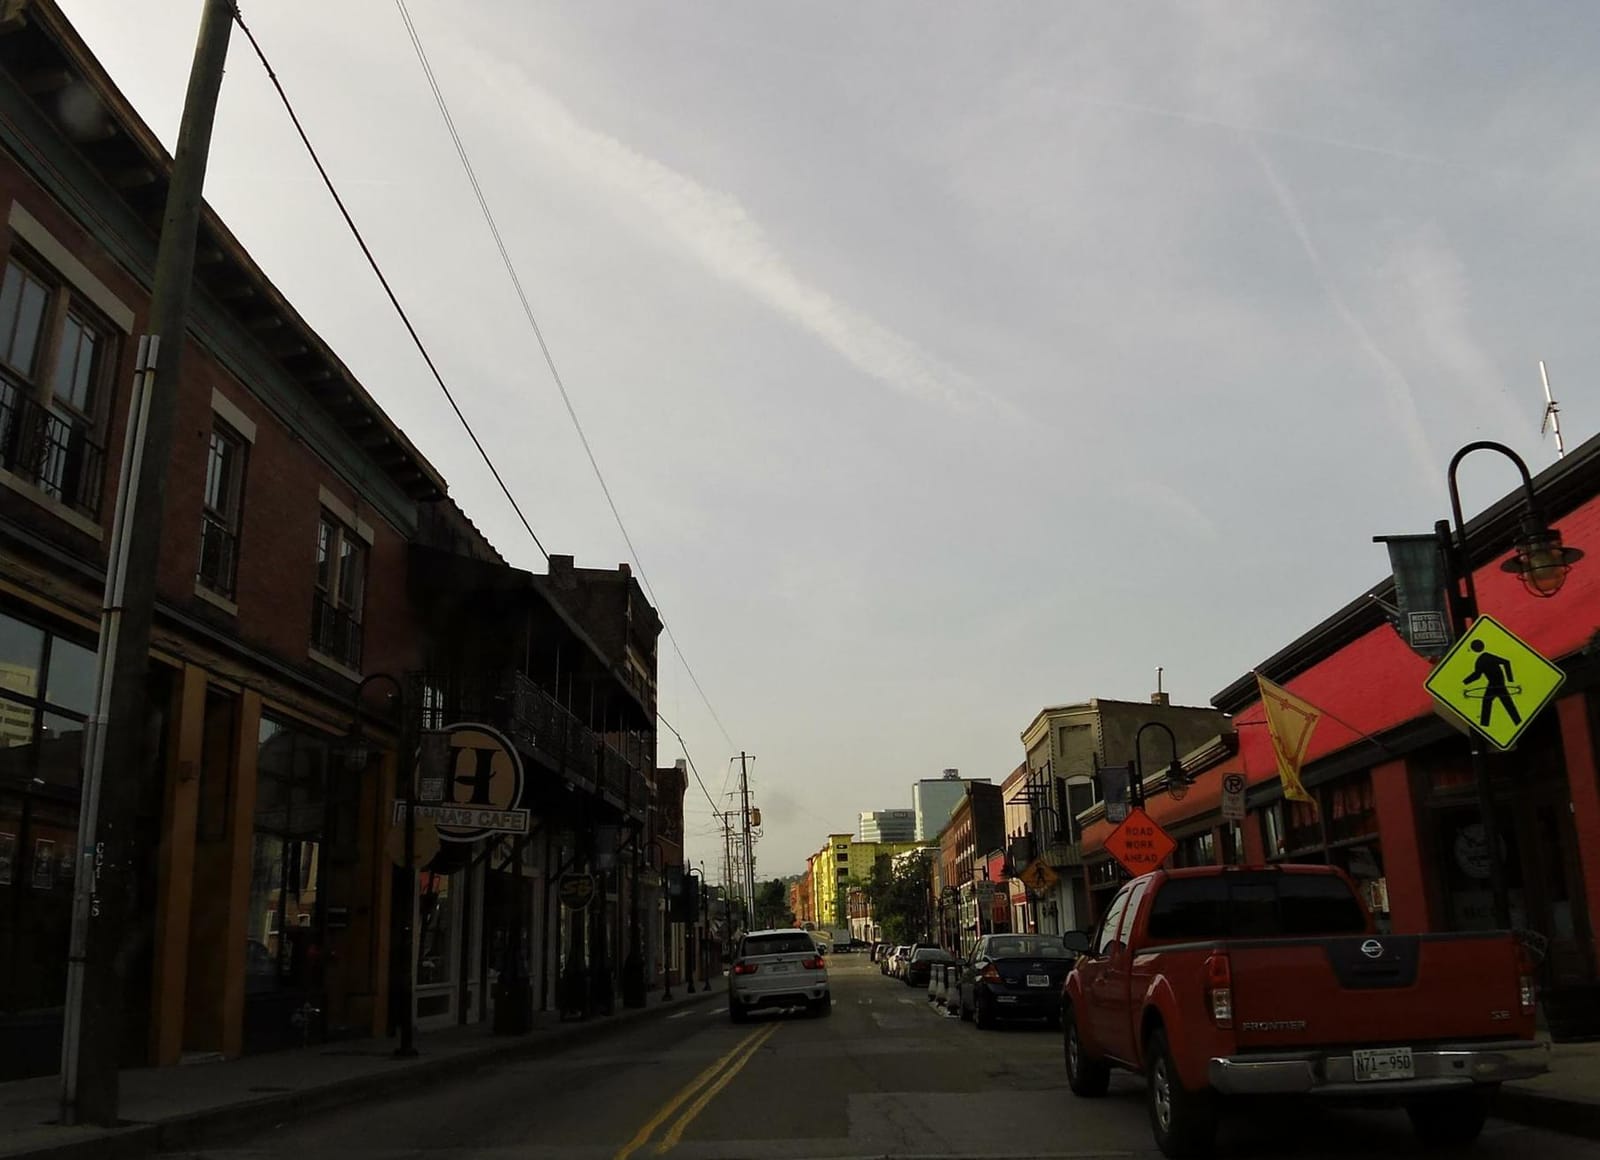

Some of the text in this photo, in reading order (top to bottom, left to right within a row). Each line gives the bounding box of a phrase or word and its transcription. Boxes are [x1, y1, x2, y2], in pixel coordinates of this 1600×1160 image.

[447, 745, 503, 805] H
[400, 805, 523, 829] ANNA'S CAFE
[1126, 827, 1153, 836] ROAD
[1126, 841, 1152, 849] WORK
[1124, 854, 1158, 863] AHEAD
[1242, 1020, 1308, 1033] FRONTIER
[1357, 1055, 1411, 1072] N71-950
